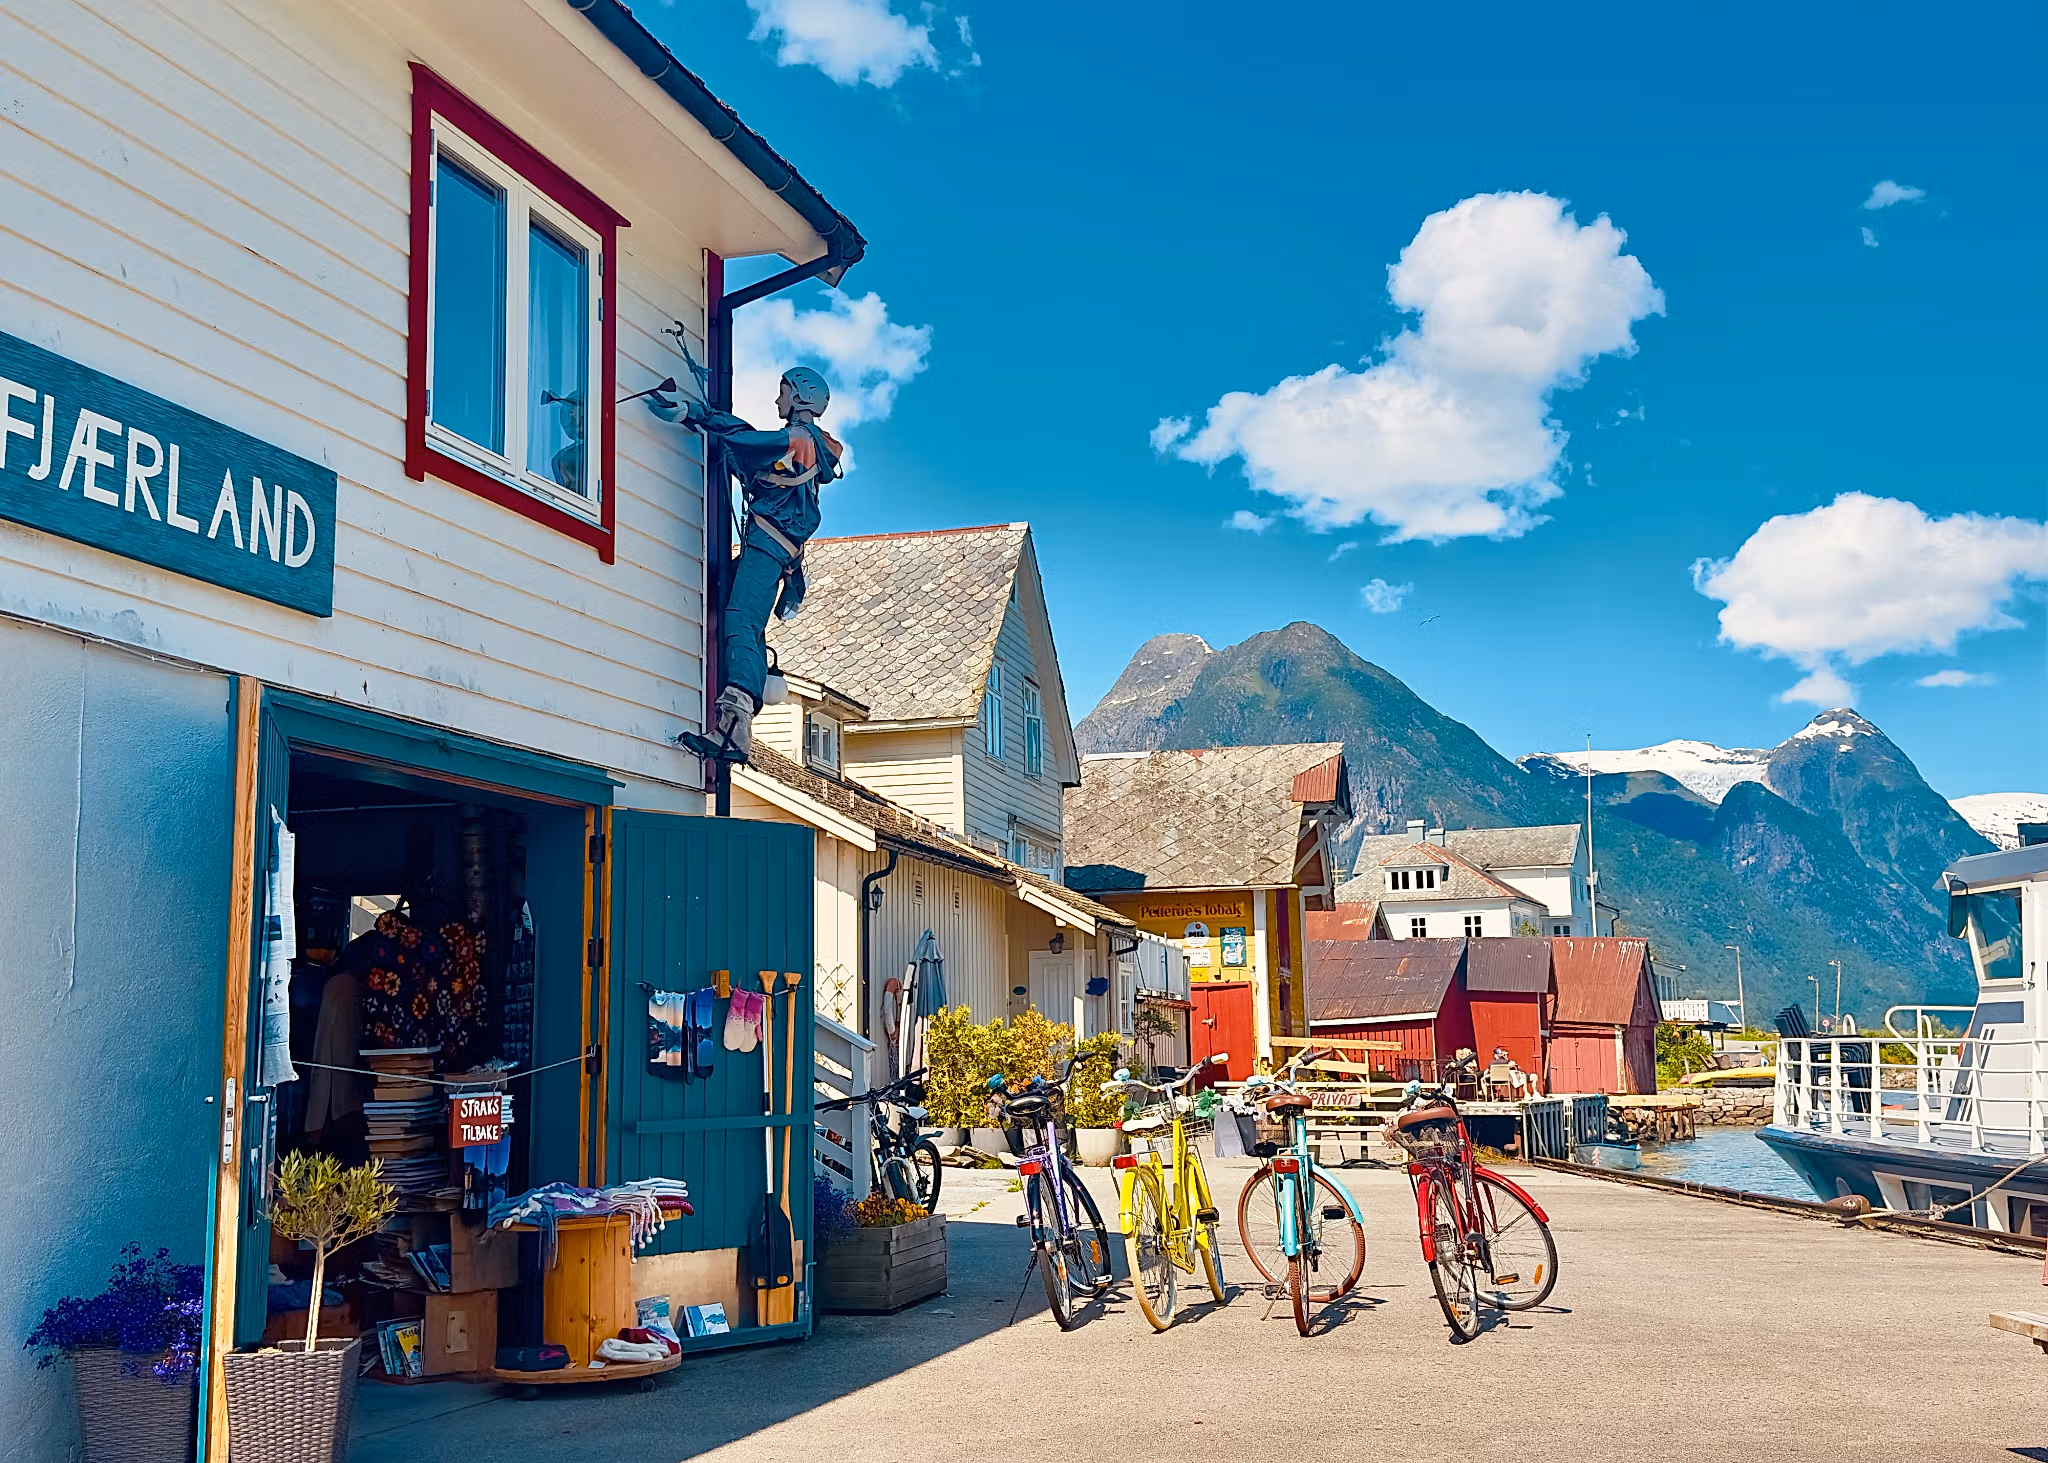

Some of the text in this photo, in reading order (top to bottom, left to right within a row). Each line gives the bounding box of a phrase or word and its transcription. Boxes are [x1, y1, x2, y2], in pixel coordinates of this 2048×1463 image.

[0, 376, 316, 568] FJÆRLAND
[1203, 903, 1242, 917] Tobak
[460, 1098, 500, 1118] STRAKS
[1309, 1092, 1358, 1106] PRIVAT
[460, 1124, 499, 1142] TILBAKE
